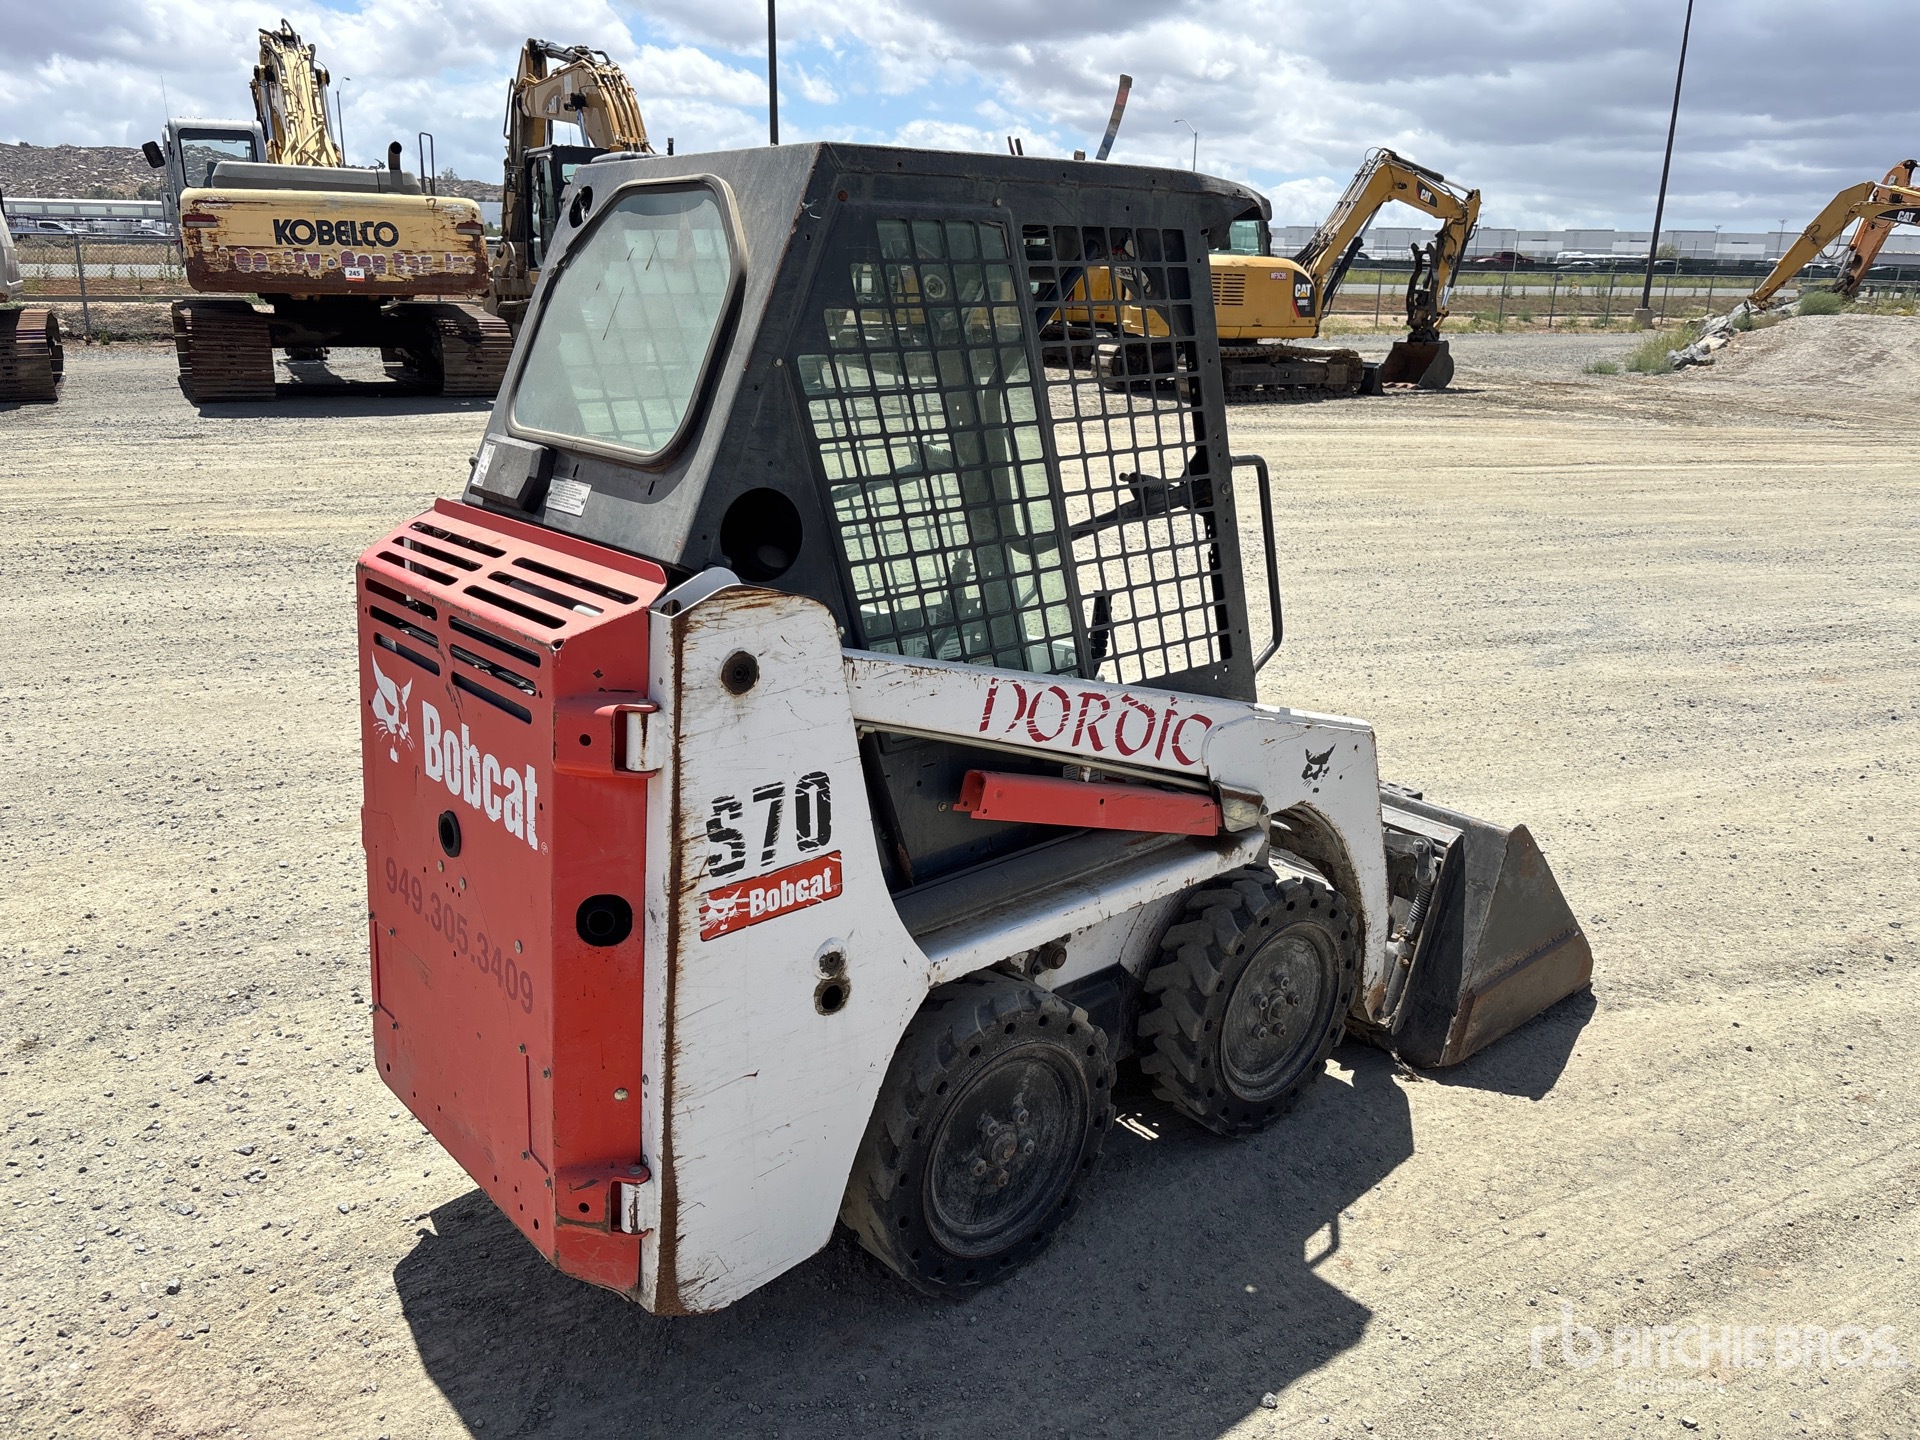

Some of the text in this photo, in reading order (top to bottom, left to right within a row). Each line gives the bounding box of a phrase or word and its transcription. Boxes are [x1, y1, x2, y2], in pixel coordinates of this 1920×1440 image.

[273, 219, 399, 247] KOBELCO
[1897, 210, 1916, 223] CAT
[348, 269, 361, 277] 245
[1294, 284, 1312, 297] CAT
[422, 700, 538, 851] Bobcat
[706, 771, 832, 878] S70
[749, 867, 832, 918] Bobcat
[385, 856, 534, 1015] 949.305.3409
